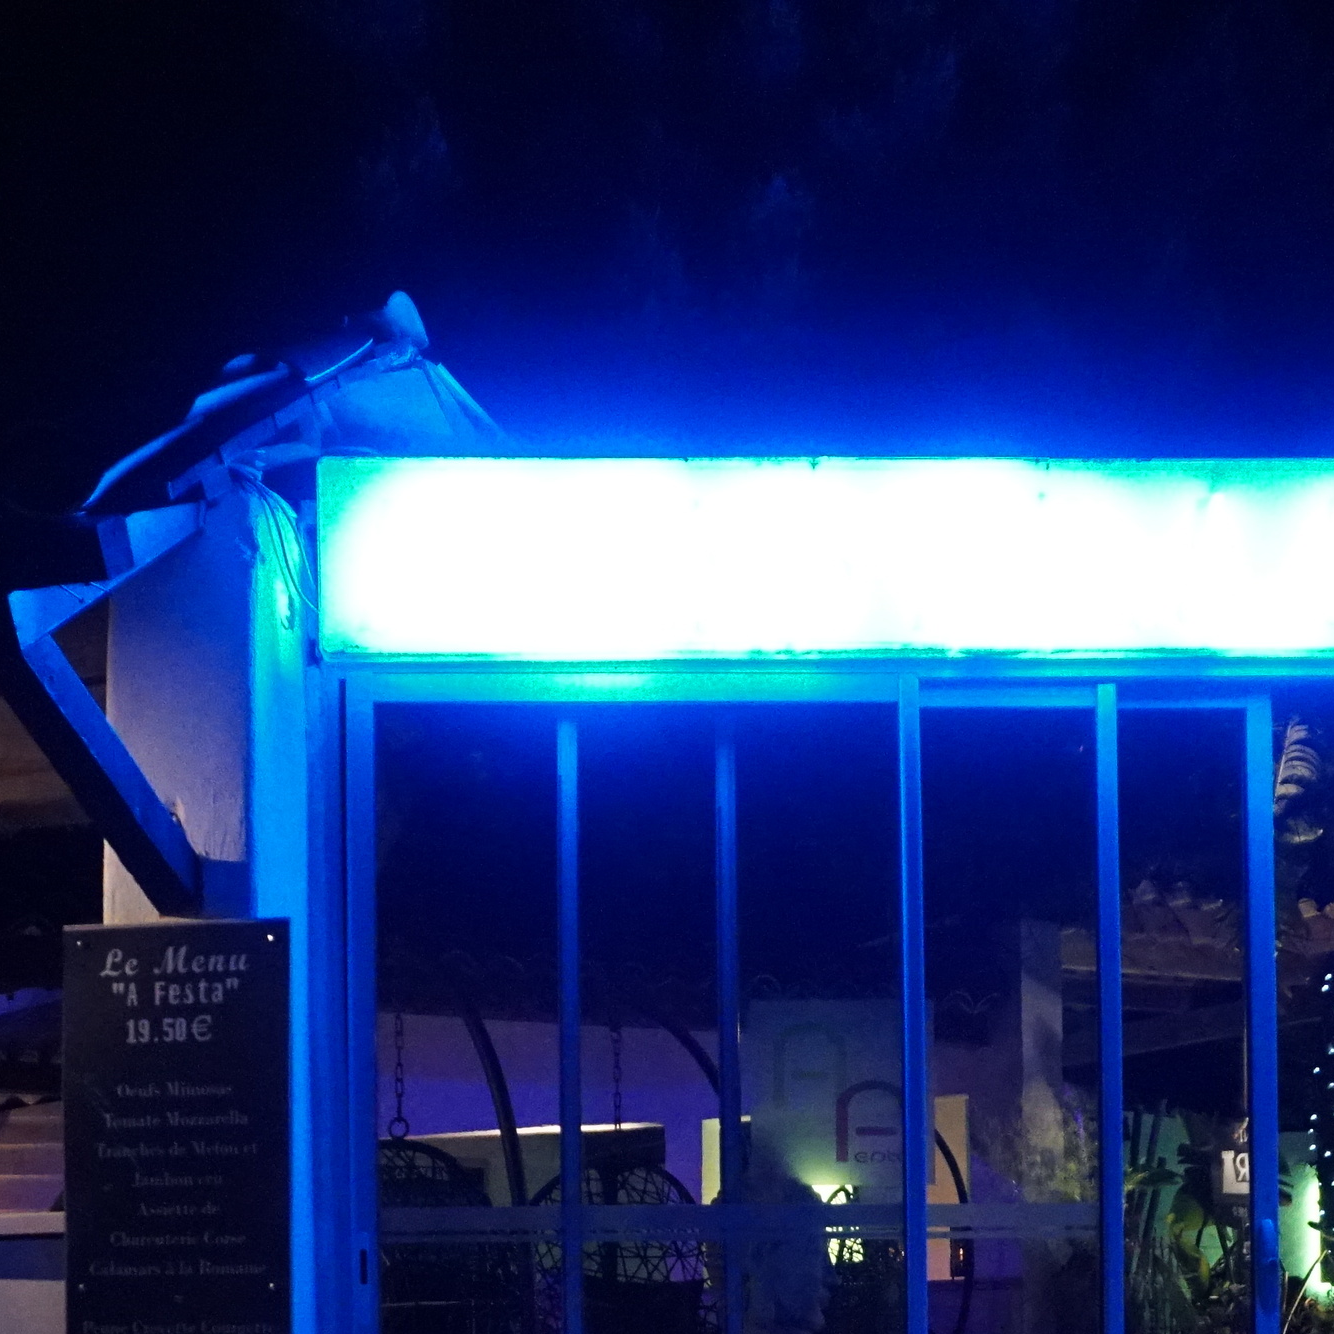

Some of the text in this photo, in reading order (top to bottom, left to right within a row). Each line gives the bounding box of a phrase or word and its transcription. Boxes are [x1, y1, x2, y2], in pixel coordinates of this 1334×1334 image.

[100, 945, 250, 977] Le Menu
[126, 1014, 213, 1044] 19.50€
